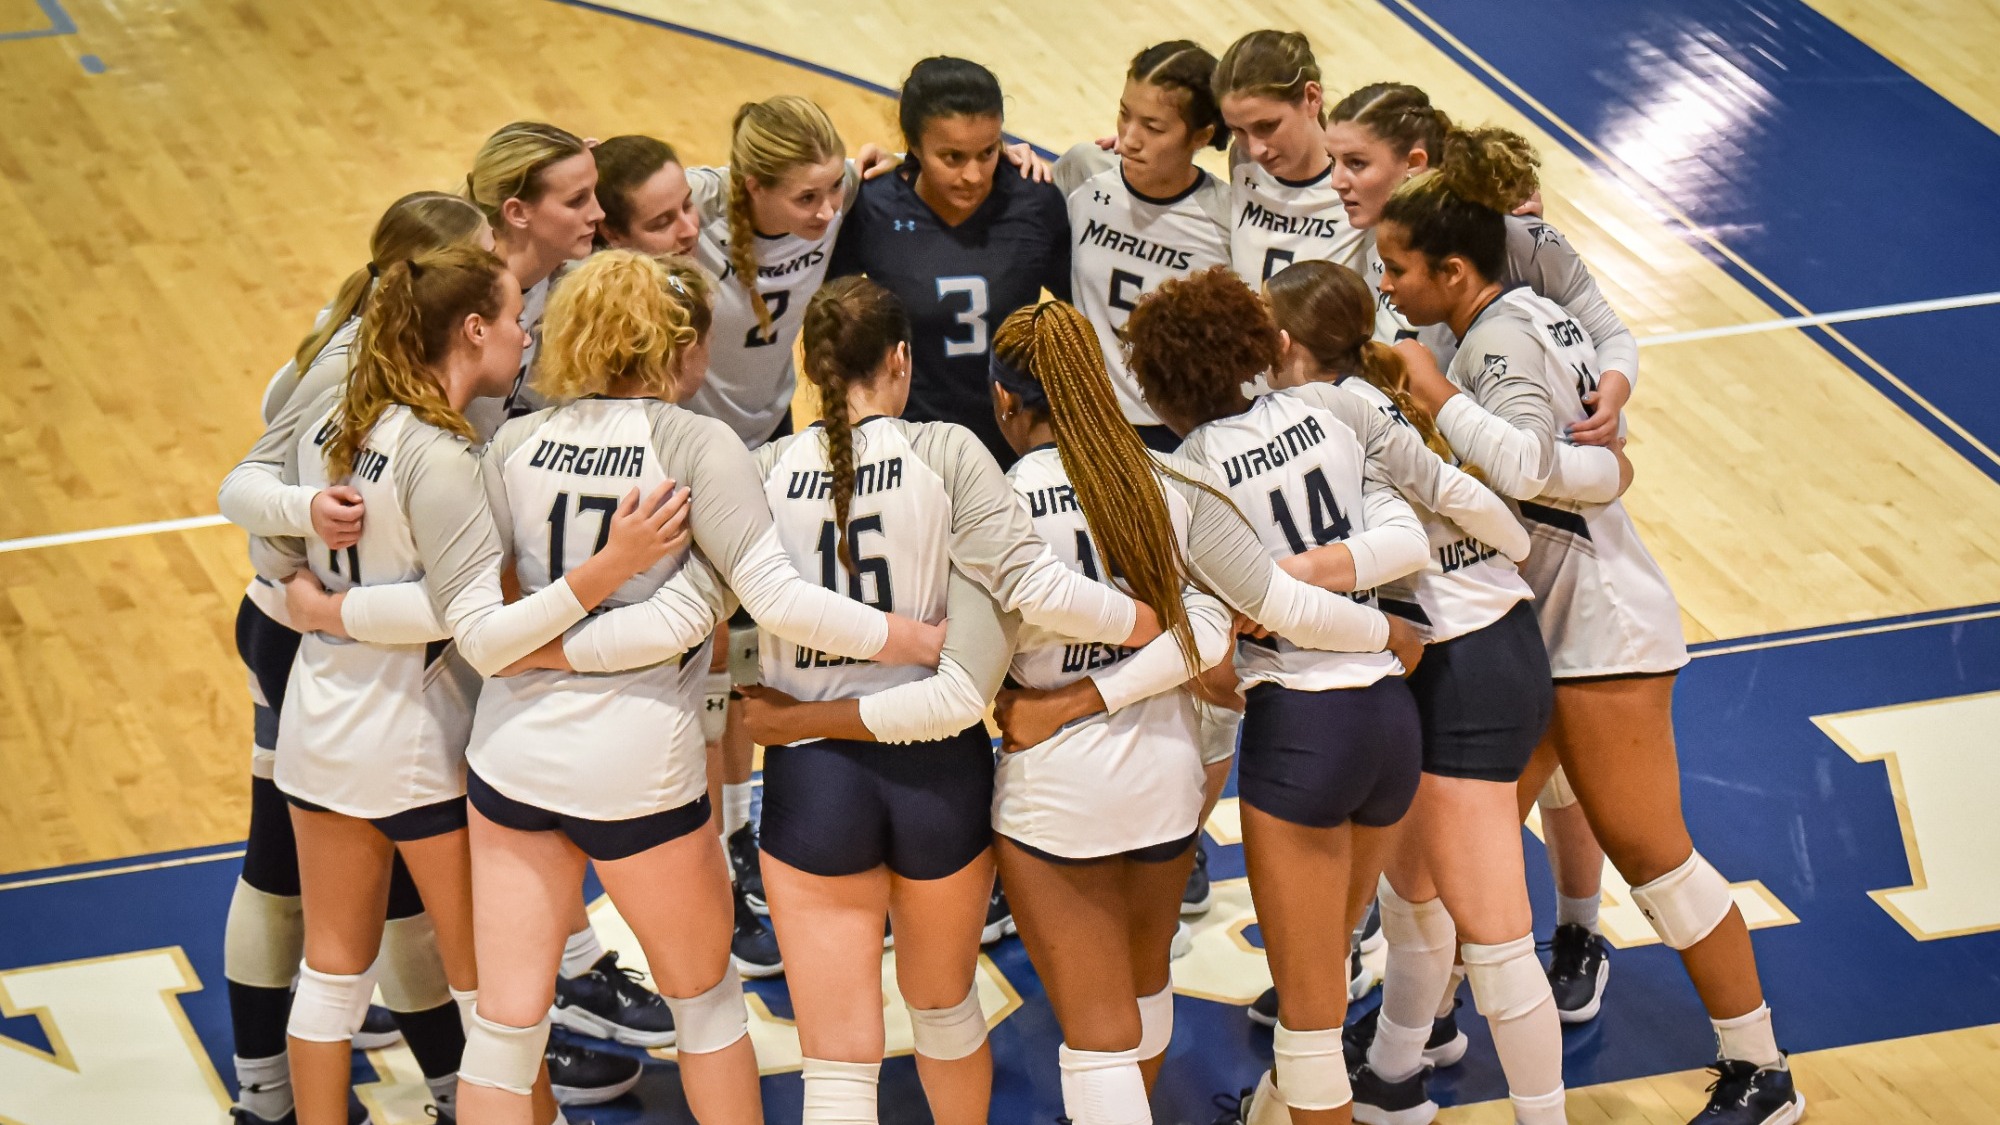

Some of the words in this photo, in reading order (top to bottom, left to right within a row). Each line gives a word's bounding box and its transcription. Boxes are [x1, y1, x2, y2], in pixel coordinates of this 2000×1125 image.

[1079, 218, 1195, 271] MARLINS
[1238, 200, 1340, 239] MARLINS
[718, 242, 825, 281] MRLINS
[744, 289, 791, 348] 2
[935, 275, 990, 358] 3
[529, 439, 645, 478] VIRGINIA
[787, 457, 903, 500] VIRNIA
[1222, 415, 1326, 488] VIRGINIA
[547, 489, 621, 583] 17
[1267, 464, 1353, 556] 14
[814, 511, 895, 614] 16
